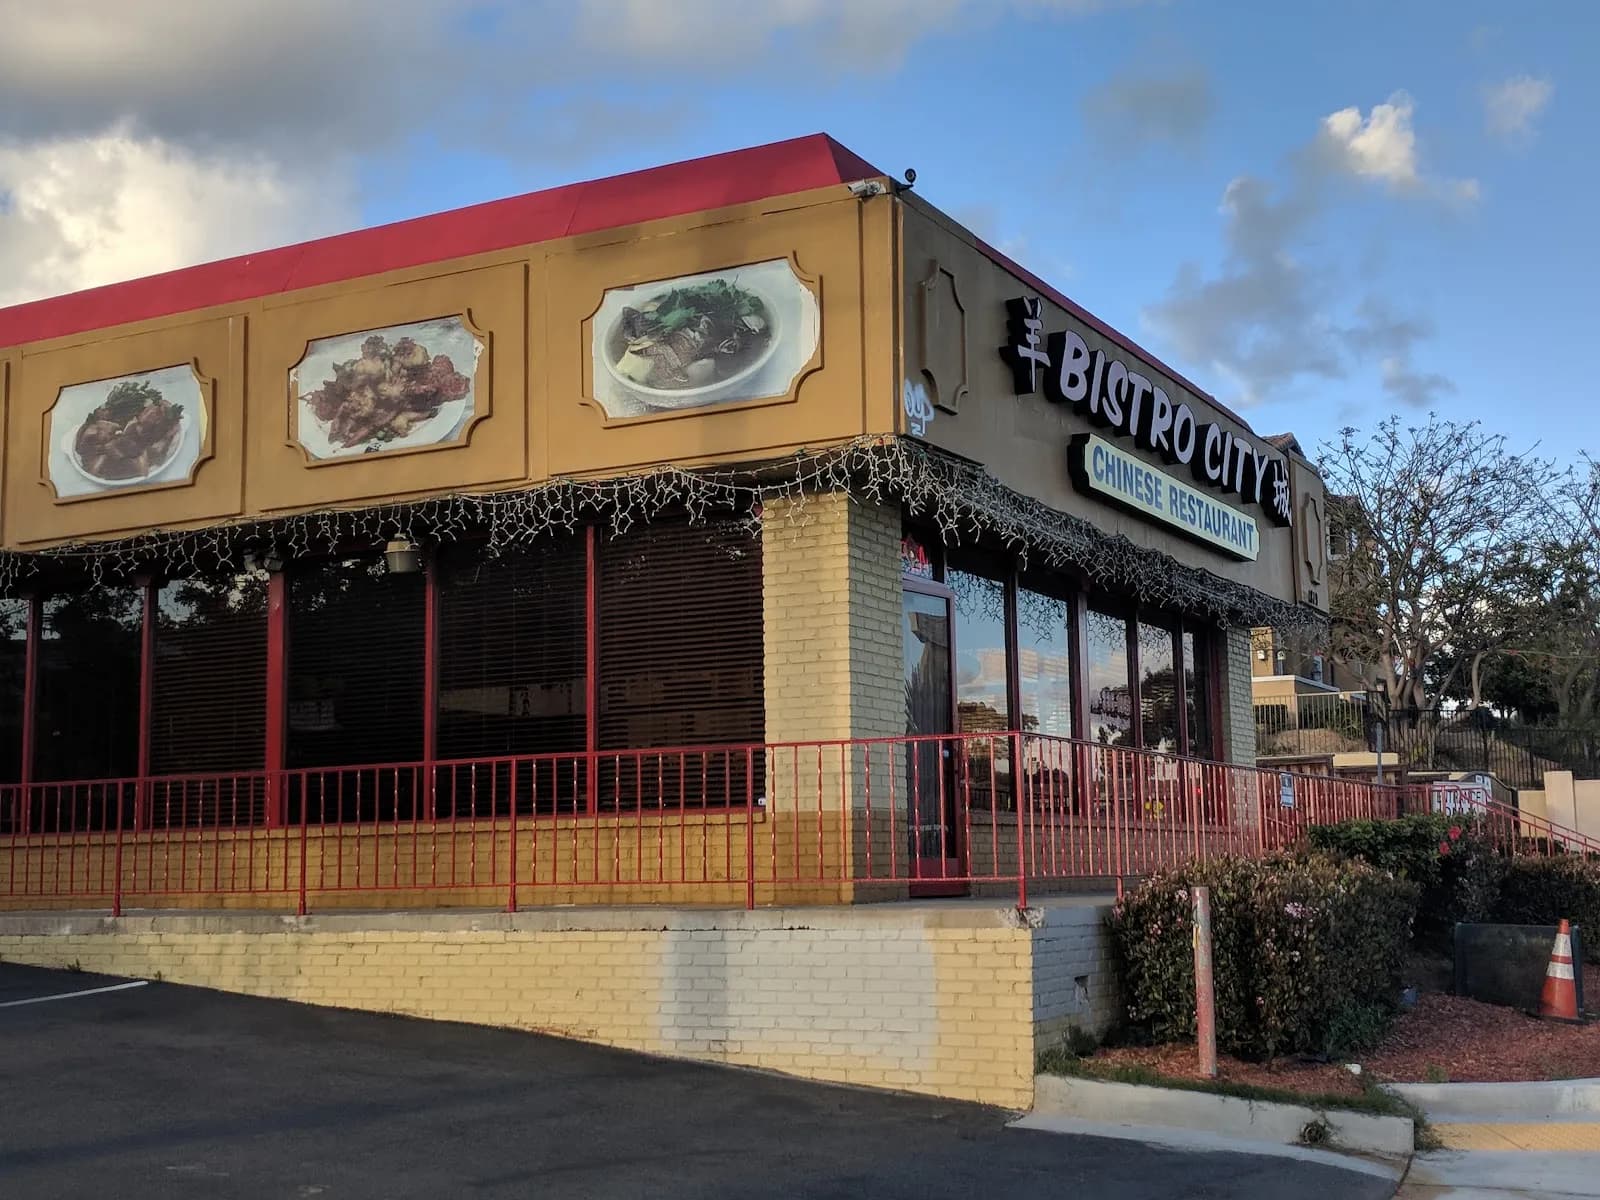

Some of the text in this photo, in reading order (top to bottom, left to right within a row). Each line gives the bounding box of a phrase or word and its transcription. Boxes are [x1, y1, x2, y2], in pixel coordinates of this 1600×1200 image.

[1060, 330, 1196, 464] BISTRO
[1204, 422, 1269, 504] CITY
[1092, 445, 1254, 552] CHINESE RESTAURANT
